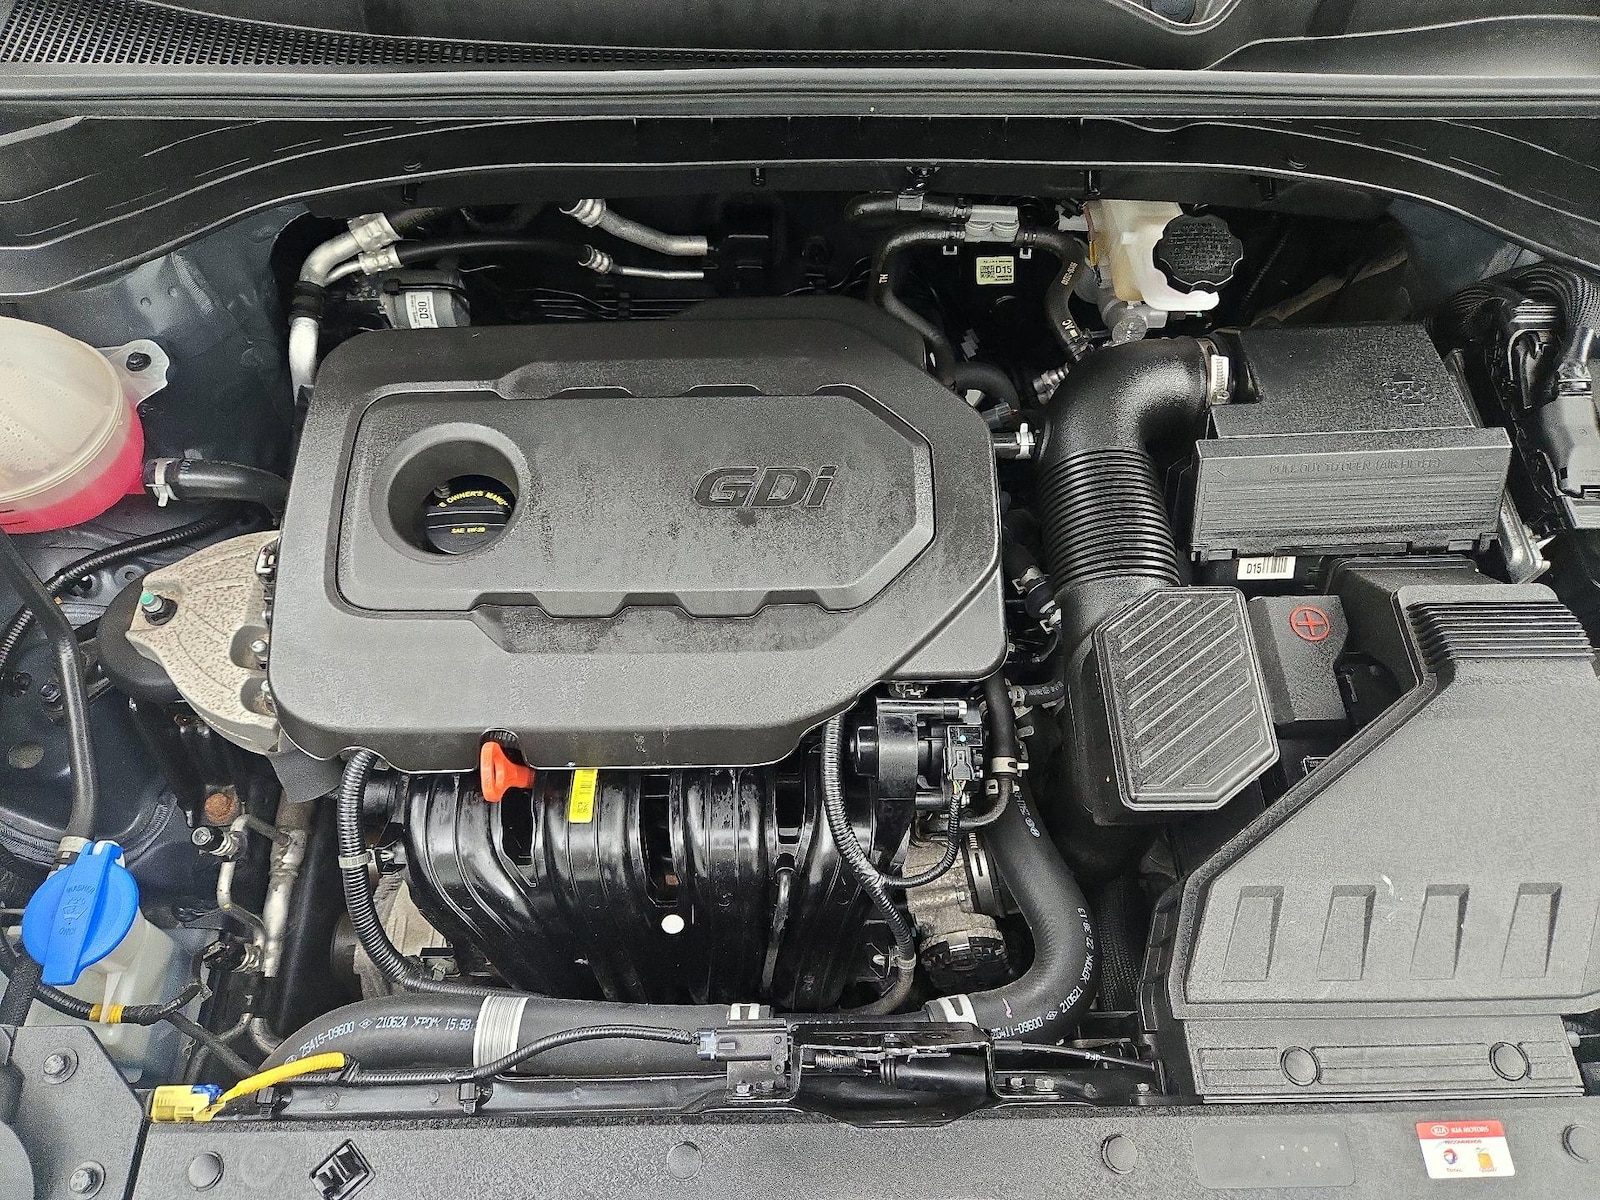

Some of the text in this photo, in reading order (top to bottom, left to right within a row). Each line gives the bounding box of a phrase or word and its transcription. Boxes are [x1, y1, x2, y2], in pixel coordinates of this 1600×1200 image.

[995, 265, 1012, 274] D15
[418, 301, 429, 319] D30
[693, 465, 839, 508] GDi
[446, 490, 484, 503] OWNER'S
[1246, 563, 1262, 574] D15
[299, 1020, 355, 1058] 25415-09600
[375, 1016, 409, 1030] 210624
